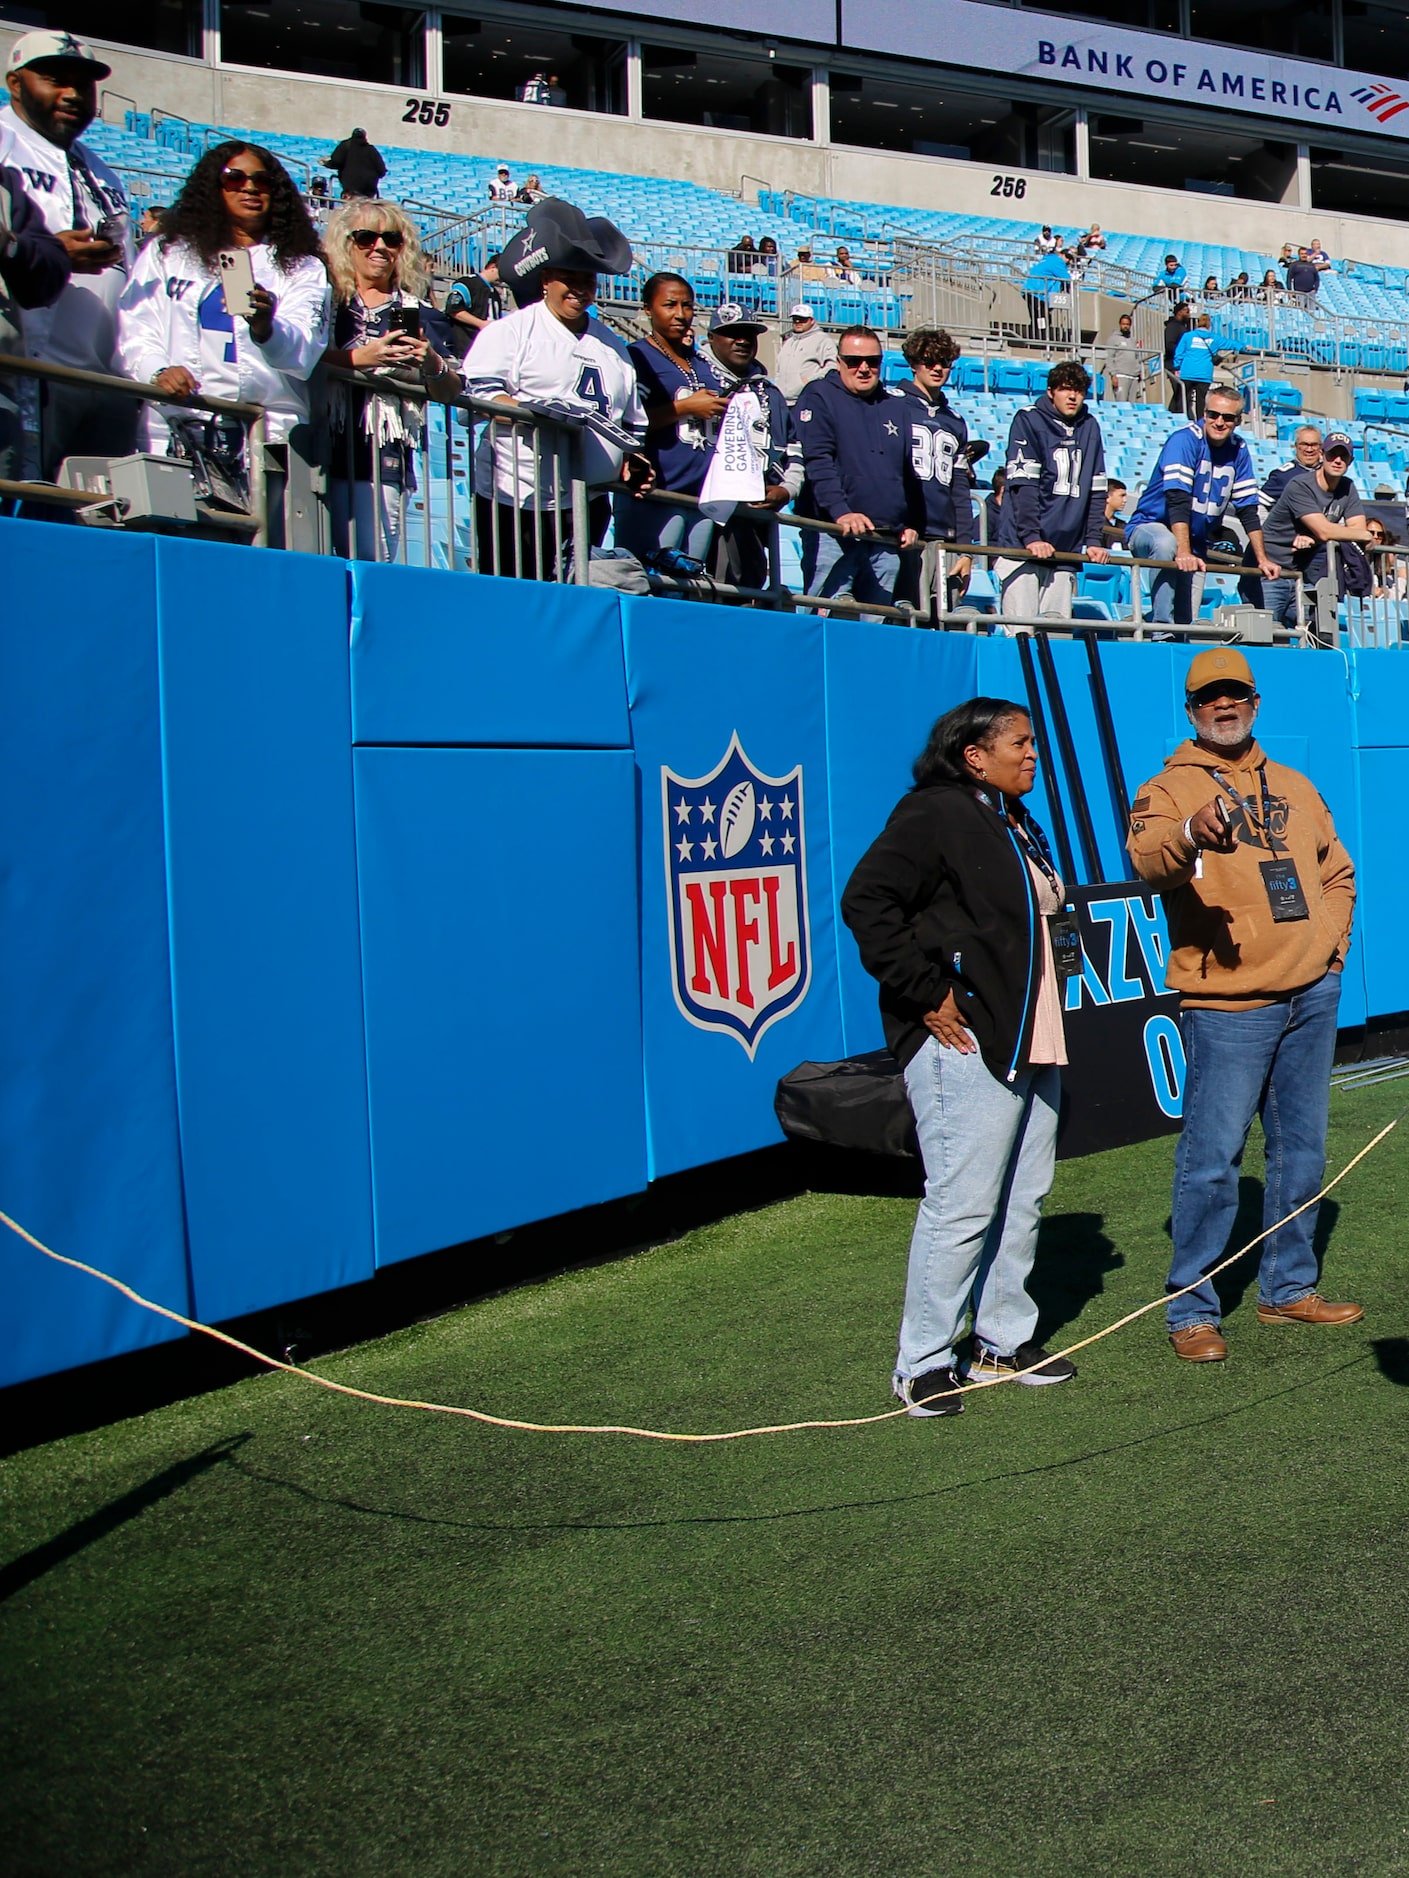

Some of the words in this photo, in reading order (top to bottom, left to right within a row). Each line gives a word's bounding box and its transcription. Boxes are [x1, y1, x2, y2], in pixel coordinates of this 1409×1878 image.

[1038, 40, 1134, 79] BANK
[1145, 60, 1187, 86] OF
[1197, 69, 1343, 114] AMERICA
[402, 98, 451, 127] 255
[990, 174, 1027, 200] 256
[513, 245, 551, 278] COWBOYS
[573, 363, 613, 419] 4
[724, 405, 737, 472] POWERING
[736, 435, 748, 472] GAME
[911, 423, 960, 487] 88
[1330, 432, 1351, 445] TCU
[1052, 447, 1082, 498] 11
[1191, 459, 1236, 517] 33
[1269, 877, 1298, 892] fifty3
[686, 875, 797, 1009] NFL
[1054, 932, 1078, 947] fifty3
